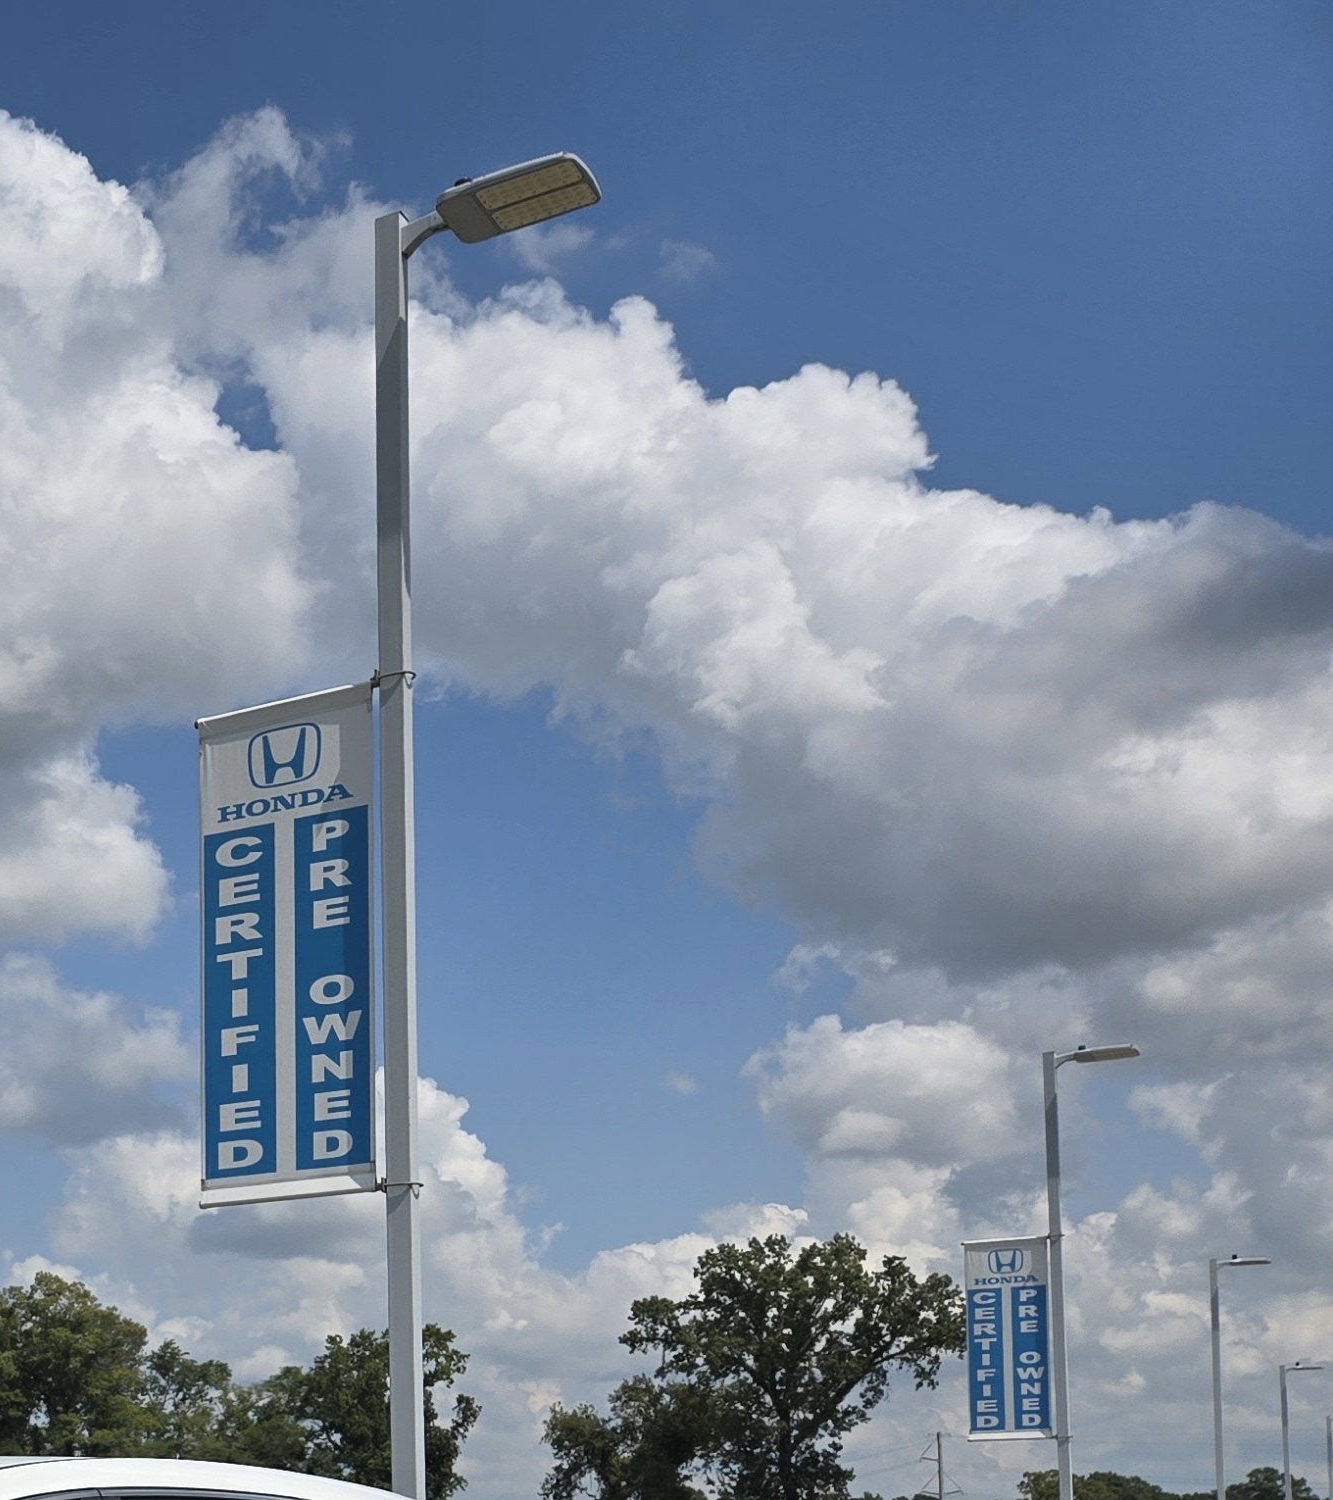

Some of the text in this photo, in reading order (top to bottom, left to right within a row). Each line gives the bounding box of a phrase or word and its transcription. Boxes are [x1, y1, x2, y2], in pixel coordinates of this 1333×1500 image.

[217, 783, 354, 824] HONDA
[214, 835, 264, 1171] CERTIFIED
[302, 818, 363, 1162] PRE OWNED
[973, 1274, 1040, 1286] HONDA
[972, 1291, 1000, 1429] CERTIFIED
[1016, 1288, 1045, 1428] PRE OWNED
